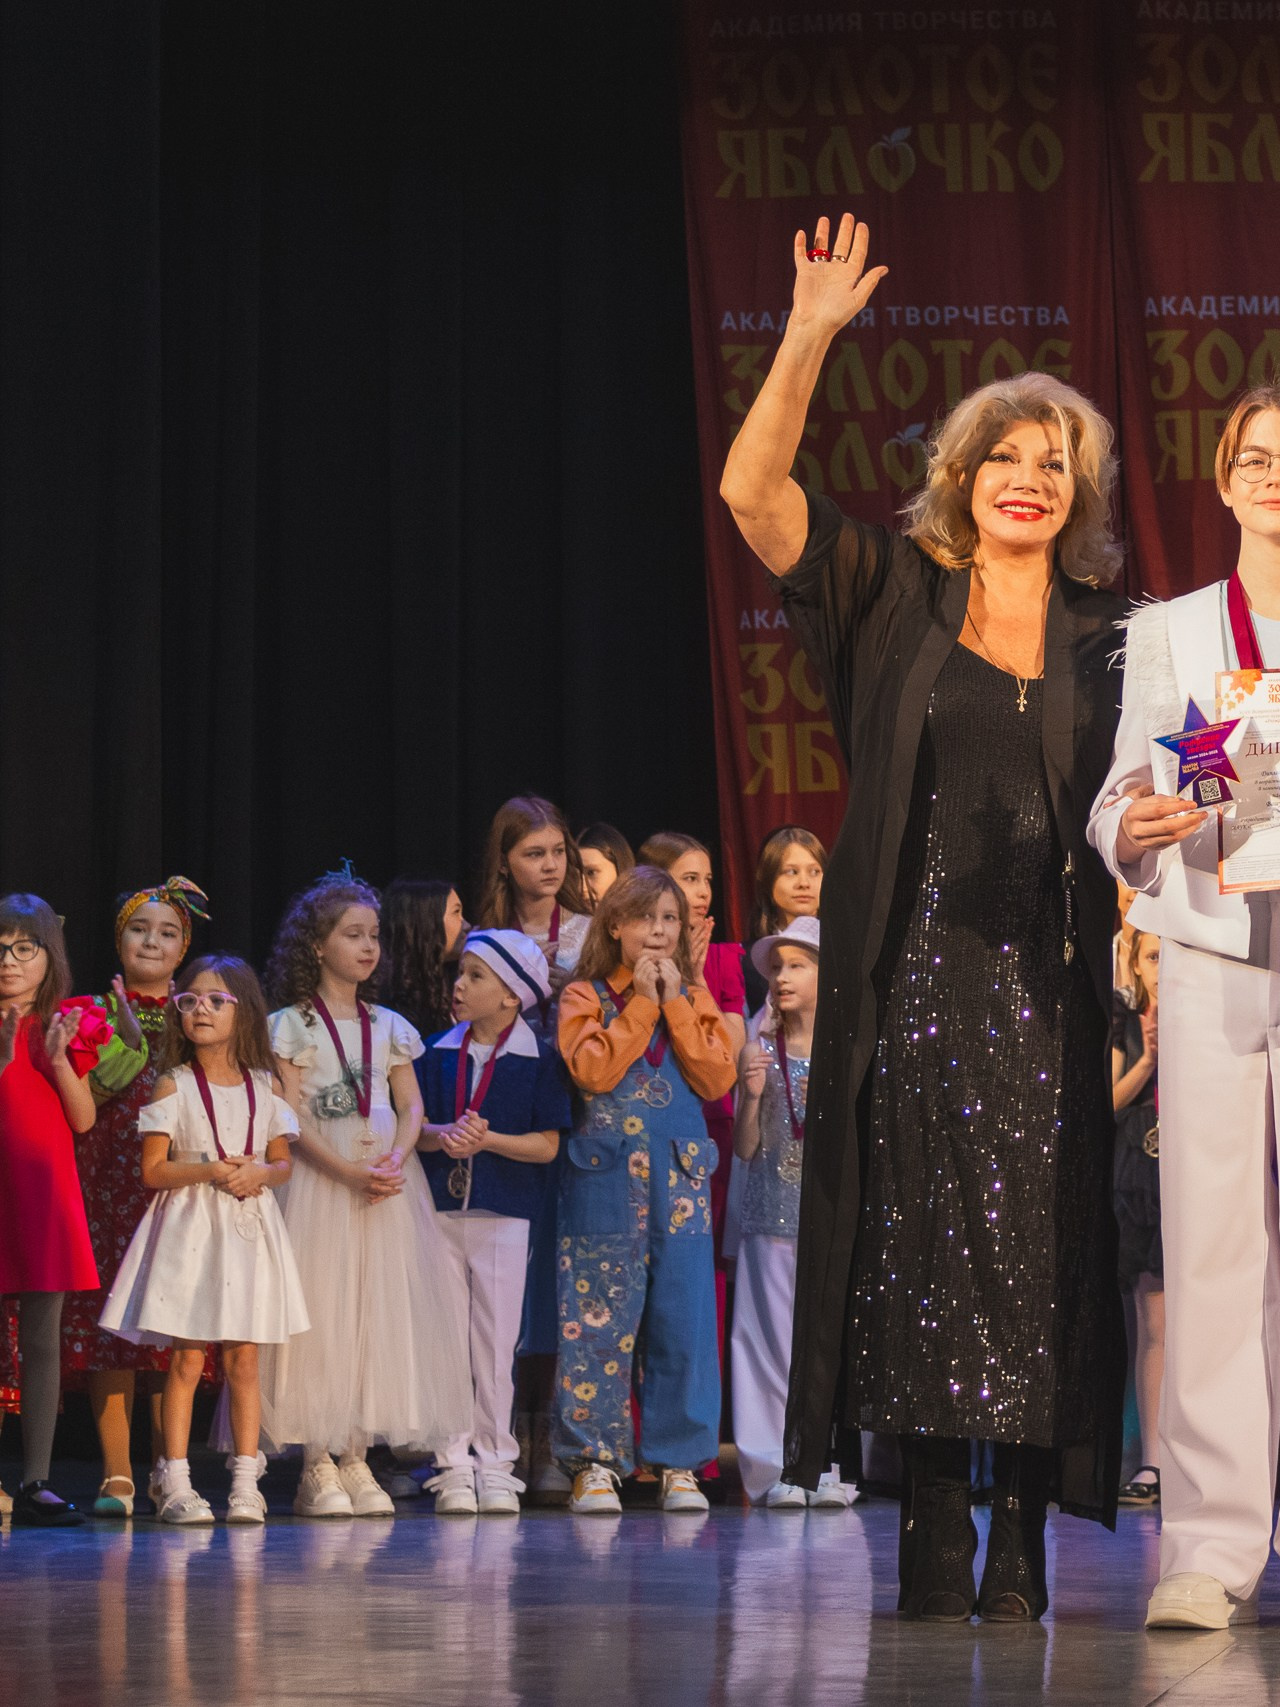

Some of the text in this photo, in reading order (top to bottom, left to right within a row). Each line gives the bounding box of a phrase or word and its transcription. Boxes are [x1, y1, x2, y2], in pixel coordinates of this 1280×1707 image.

[709, 9, 1058, 40] АКАДЕМИЯ ТВОРЧЕСТВА
[709, 41, 1059, 120] ЗОЛОТОЕ
[714, 119, 1064, 199] ЯБЛОЧКО
[886, 304, 1070, 327] ТВОРЧЕСТВА
